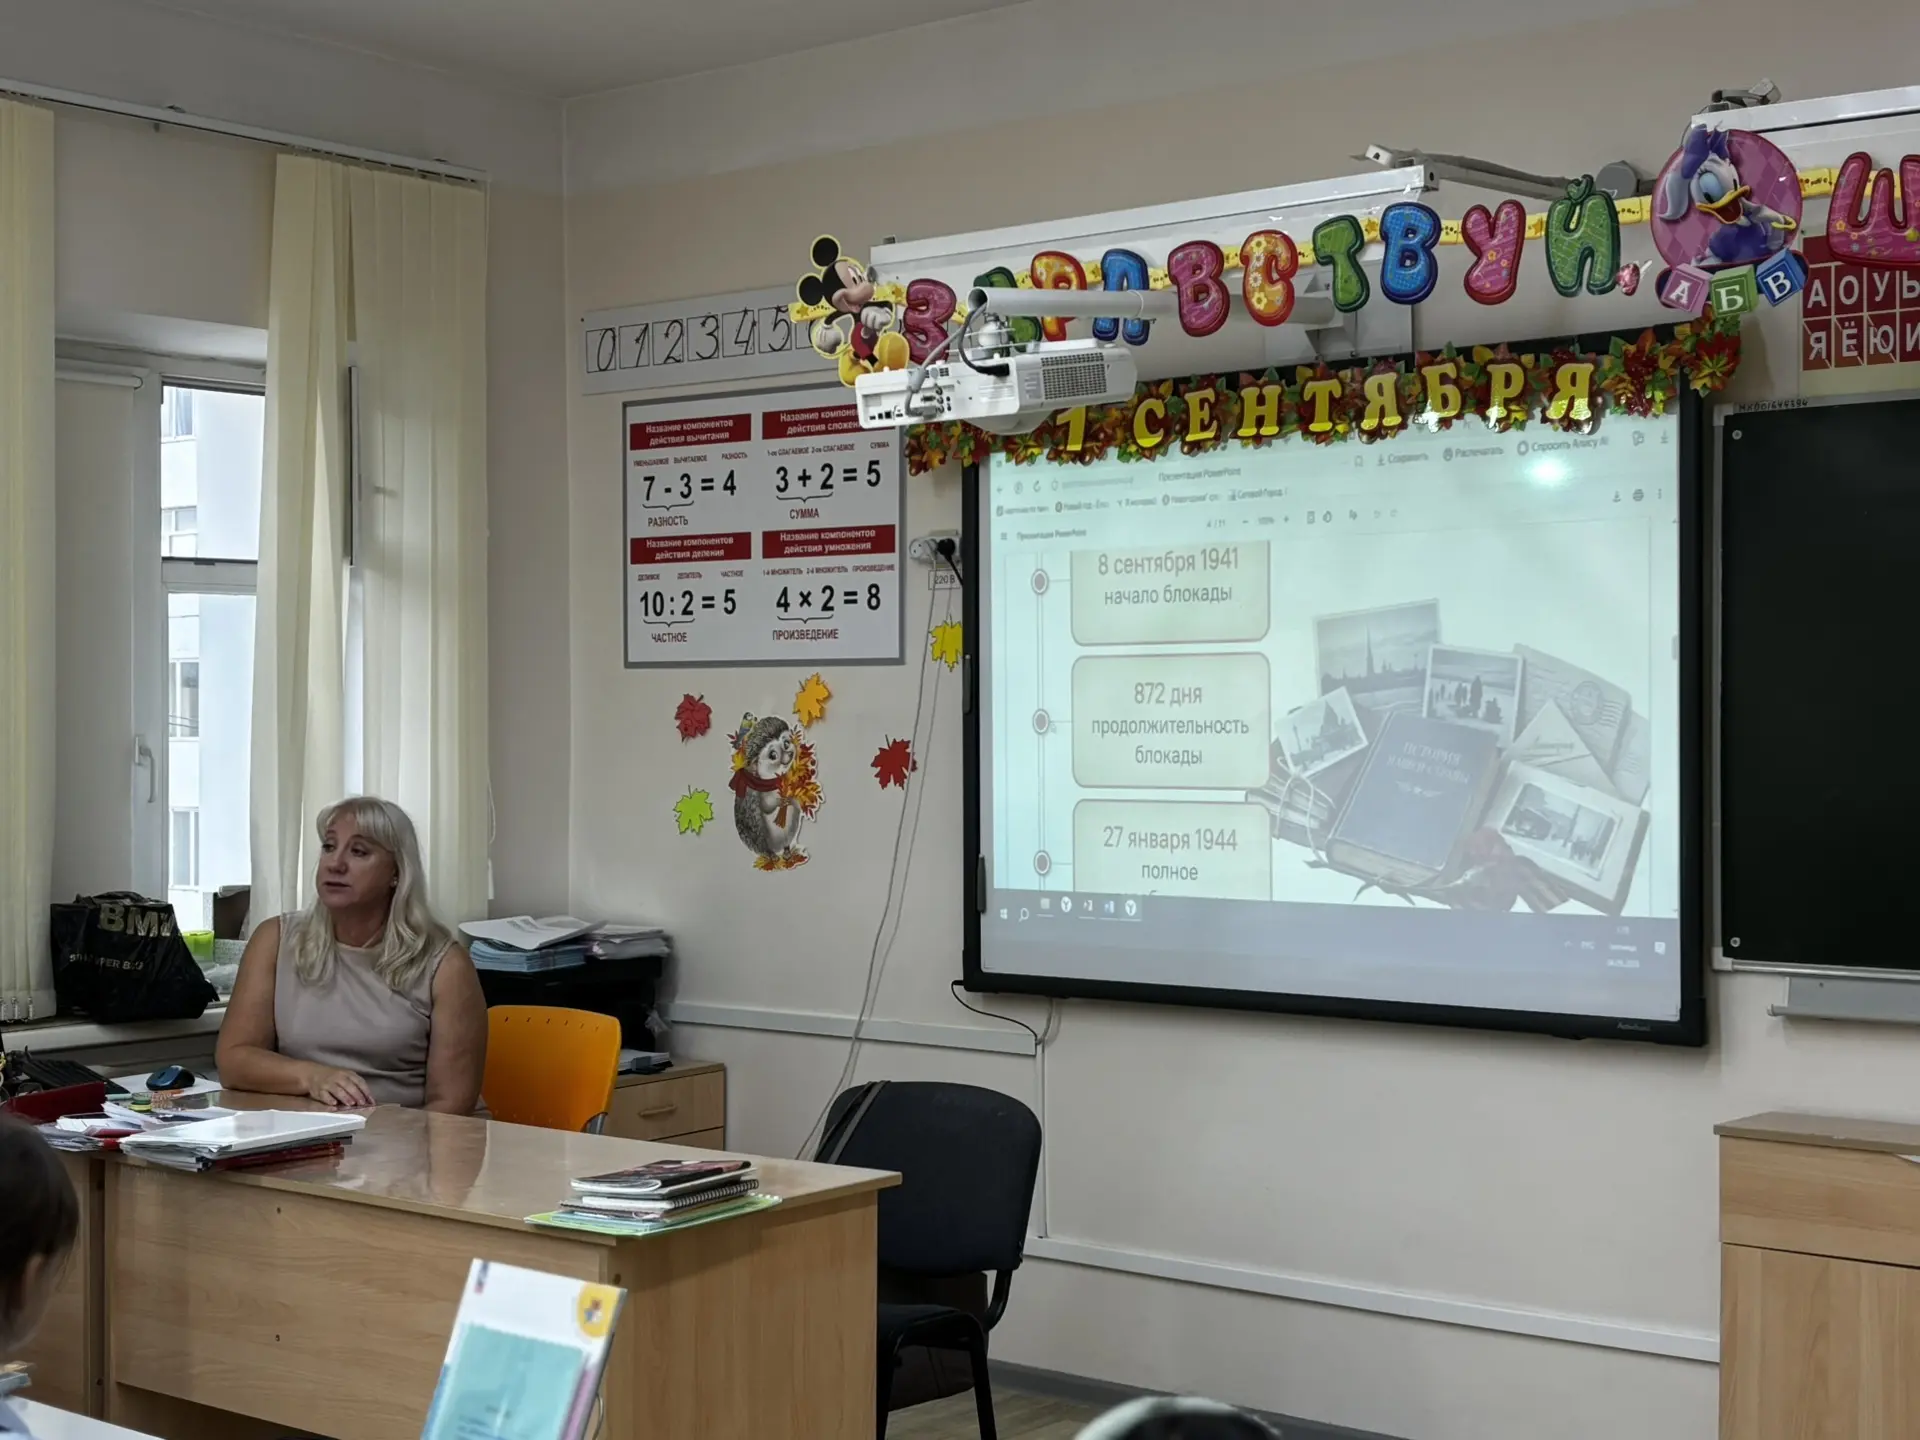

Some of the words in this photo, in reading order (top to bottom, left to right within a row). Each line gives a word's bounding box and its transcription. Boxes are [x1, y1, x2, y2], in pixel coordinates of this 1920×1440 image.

[1132, 362, 1596, 449] СЕНТЯБРЯ
[780, 411, 819, 423] Название
[645, 424, 682, 434] Название
[683, 420, 734, 431] компонентов
[787, 423, 826, 435] действия
[649, 436, 686, 447] действия
[686, 432, 730, 443] вычитания
[789, 507, 820, 520] СУММА
[648, 516, 689, 527] РАЗНОСТЬ
[646, 539, 682, 548] Название
[683, 536, 734, 546] компонентов
[780, 532, 819, 542] Название
[821, 529, 876, 539] компонентов
[655, 550, 690, 560] действия
[692, 549, 725, 559] деления
[784, 544, 822, 554] действия
[824, 542, 871, 554] умножения
[1098, 553, 1109, 575] 8
[1114, 551, 1196, 577] сентября
[1200, 547, 1239, 571] 1941
[1104, 588, 1159, 605] начало
[1163, 584, 1232, 604] блокады
[651, 632, 688, 643] ЧАСТНОЕ
[772, 628, 839, 642] ПРОИЗВЕДЕНИЕ
[1134, 682, 1166, 704] 872
[1169, 686, 1203, 707] дня
[1092, 719, 1250, 738] продолжительность
[1135, 745, 1203, 767] блокады
[1103, 825, 1124, 848] 27
[1128, 831, 1190, 853] января
[1195, 828, 1238, 851] 1944
[1141, 864, 1199, 881] полное
